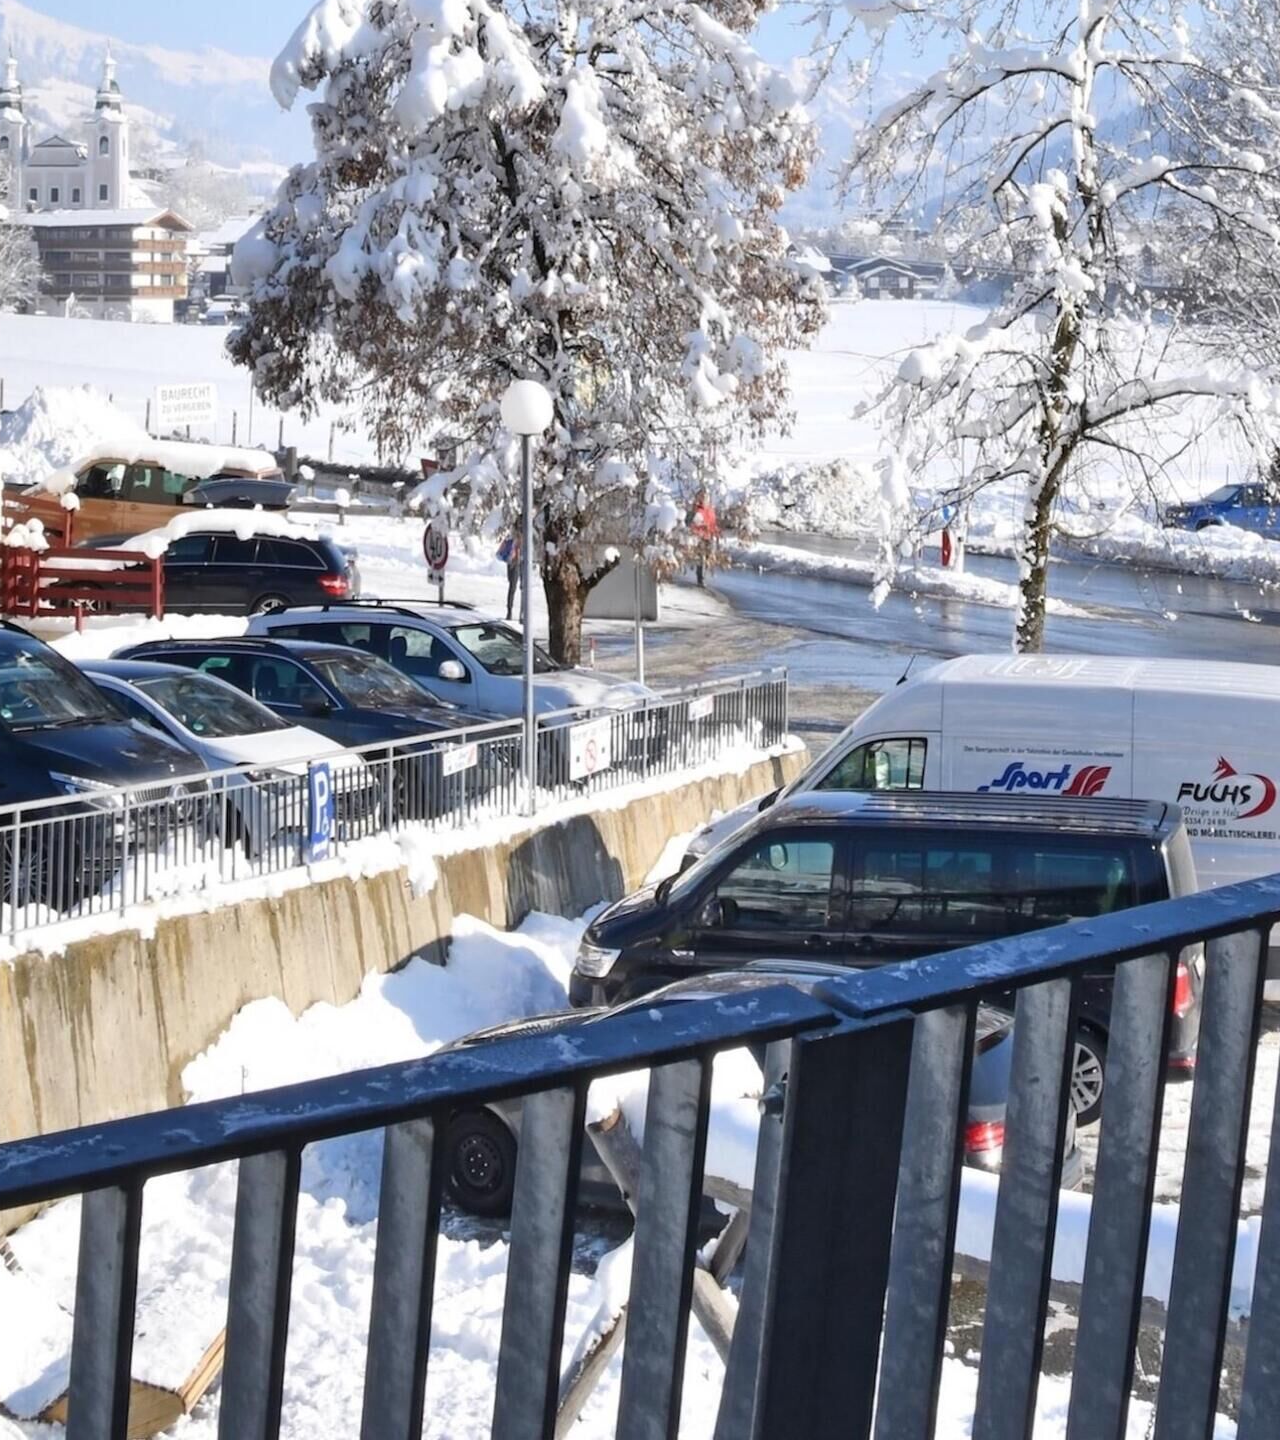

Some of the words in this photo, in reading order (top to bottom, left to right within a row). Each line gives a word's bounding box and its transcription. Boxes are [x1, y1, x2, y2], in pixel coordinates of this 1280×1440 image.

[990, 762, 1072, 791] Sport
[314, 771, 329, 834] P
[1176, 782, 1252, 806] FUCHS
